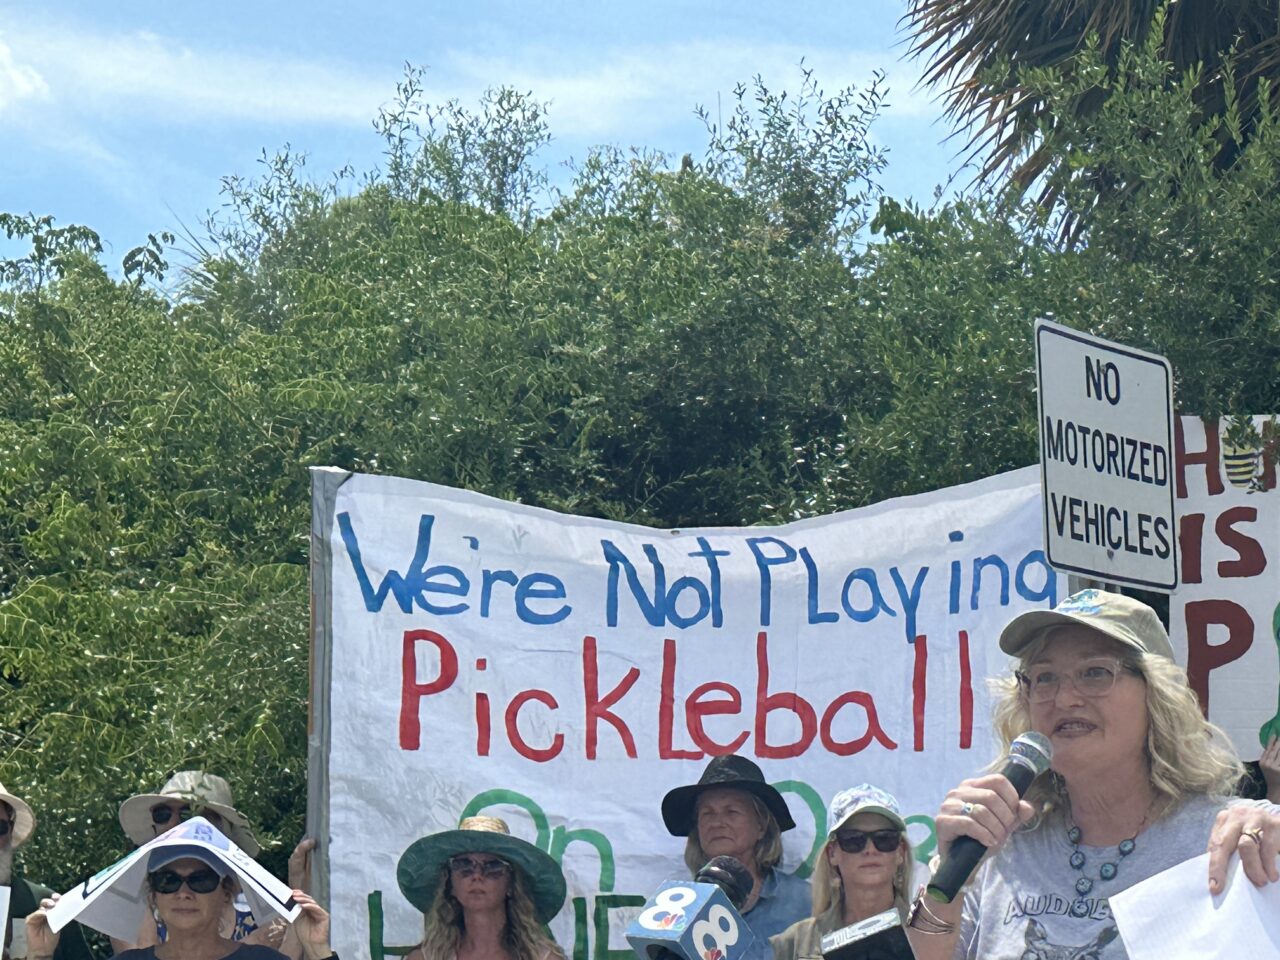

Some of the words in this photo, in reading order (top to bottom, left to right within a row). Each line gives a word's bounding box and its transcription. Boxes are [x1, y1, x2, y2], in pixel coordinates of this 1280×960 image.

[1086, 356, 1121, 405] NO
[1046, 416, 1167, 489] MOTORIZED
[1051, 494, 1170, 559] VEHICLES
[1180, 506, 1267, 584] IS
[336, 509, 572, 625] We're
[600, 536, 730, 629] Not
[638, 887, 697, 931] 8
[692, 904, 739, 960] 8
